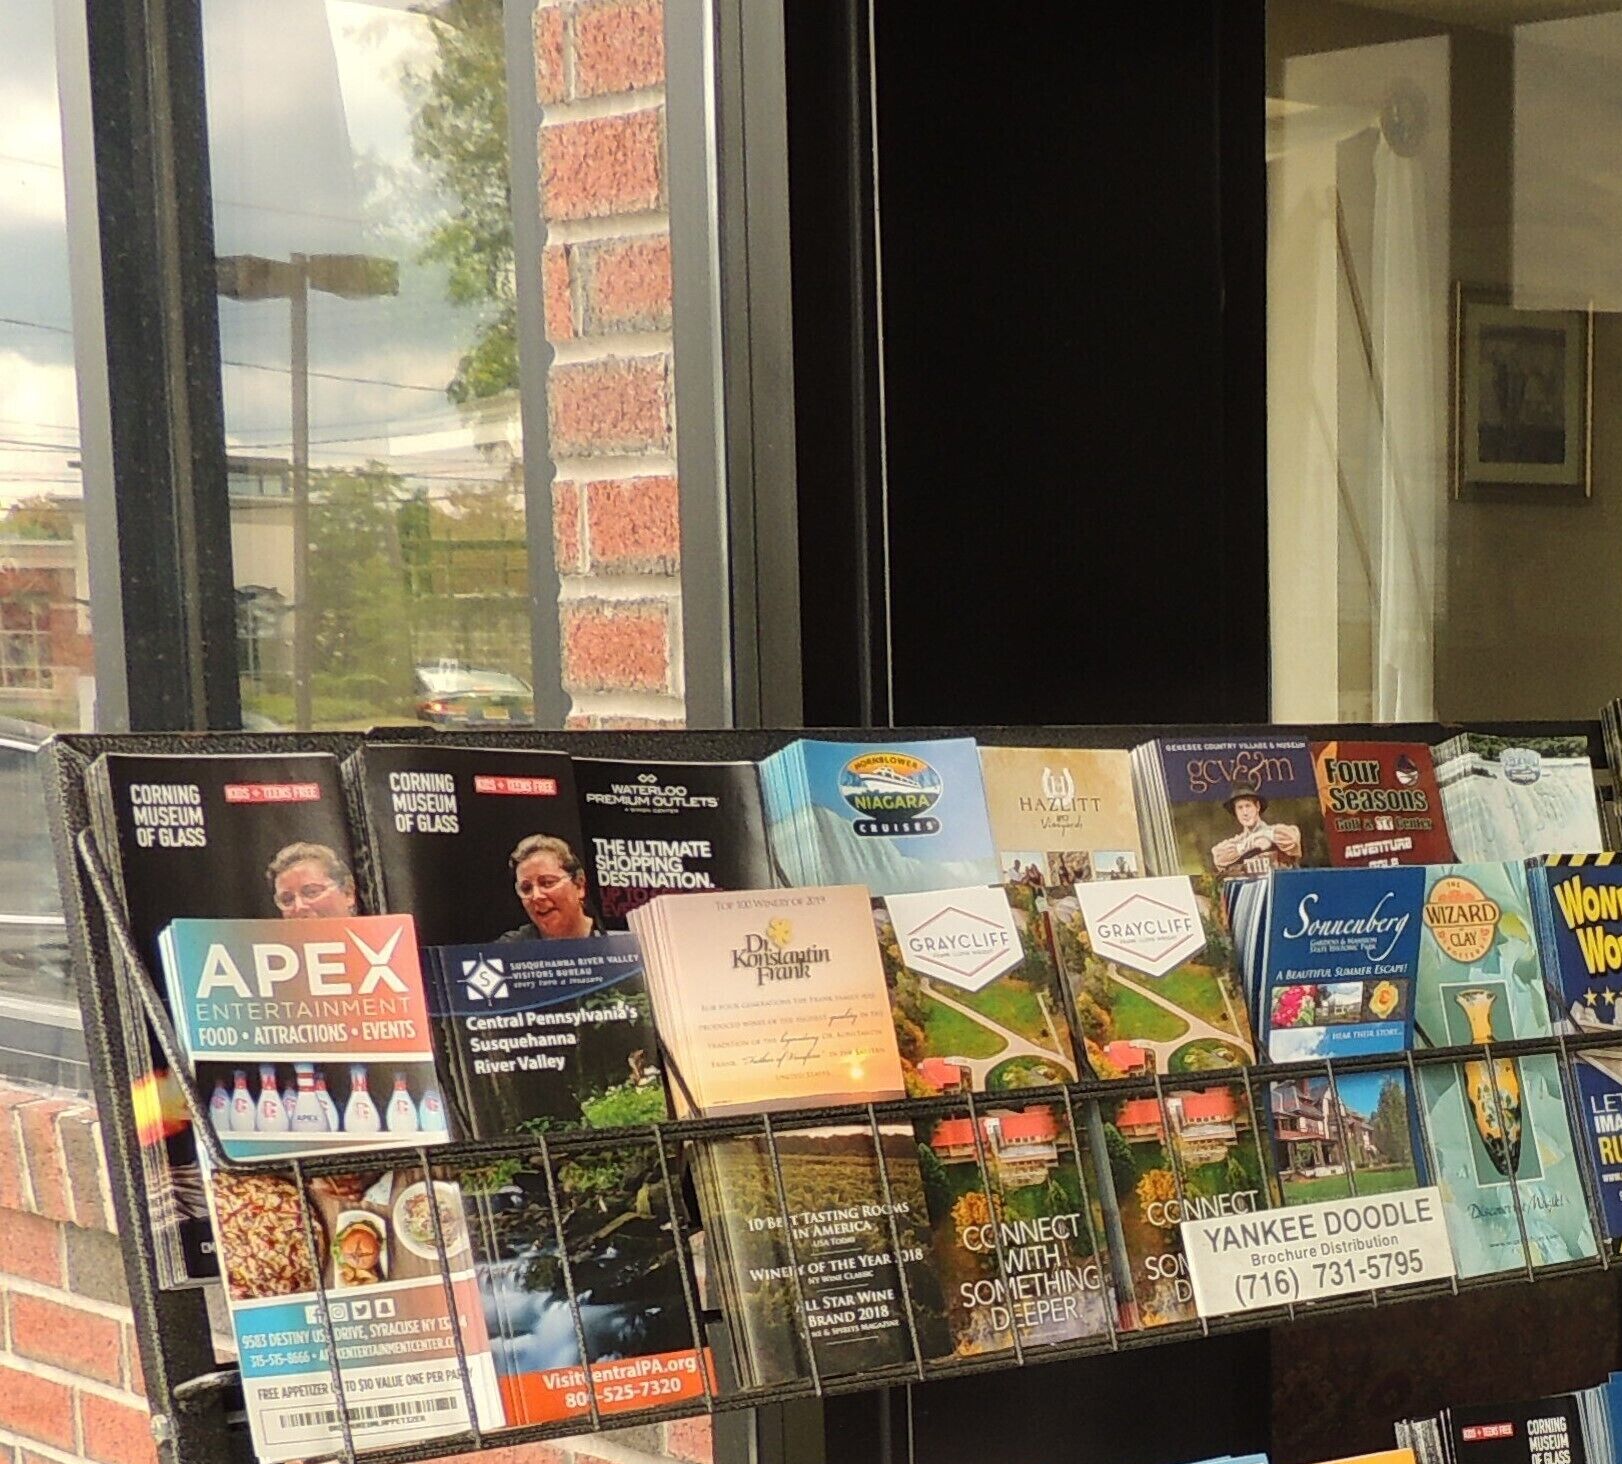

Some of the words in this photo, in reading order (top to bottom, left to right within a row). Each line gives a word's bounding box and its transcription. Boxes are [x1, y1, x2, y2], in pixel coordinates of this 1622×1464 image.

[1325, 758, 1380, 786] Four
[130, 784, 200, 805] CORNING
[586, 793, 650, 806] PREMIUM
[611, 784, 687, 796] WATERLOO
[1331, 787, 1427, 812] Seasons
[855, 793, 930, 812] NIAGARA
[1020, 796, 1102, 812] HAZLITT
[133, 805, 203, 827] MUSEUM
[136, 829, 156, 847] OF
[158, 827, 206, 848] GLASS
[593, 838, 623, 856] THE
[624, 840, 711, 858] ULTIMATE
[595, 855, 683, 873] SHOPPING
[598, 870, 715, 889] DESTINATION.
[909, 930, 1010, 952] GRAYCLIFF
[196, 924, 411, 999] APEX
[196, 996, 410, 1021] ENTERTAINMENT
[467, 1010, 523, 1031] Central
[527, 1005, 638, 1027] Pennsylvania's
[199, 1027, 238, 1046] FOOD
[254, 1023, 348, 1045] ATTRACTIONS
[362, 1021, 415, 1041] EVENTS
[471, 1031, 577, 1052] Susquehanna
[475, 1055, 516, 1074] River
[520, 1053, 565, 1073] Valley
[1204, 1213, 1317, 1253] YANKEE
[1324, 1198, 1432, 1235] DOODLE
[1250, 1245, 1319, 1267] Brochure
[1320, 1234, 1400, 1257] Distribution
[1234, 1267, 1301, 1307] (716)
[1311, 1249, 1424, 1288] 731-5795
